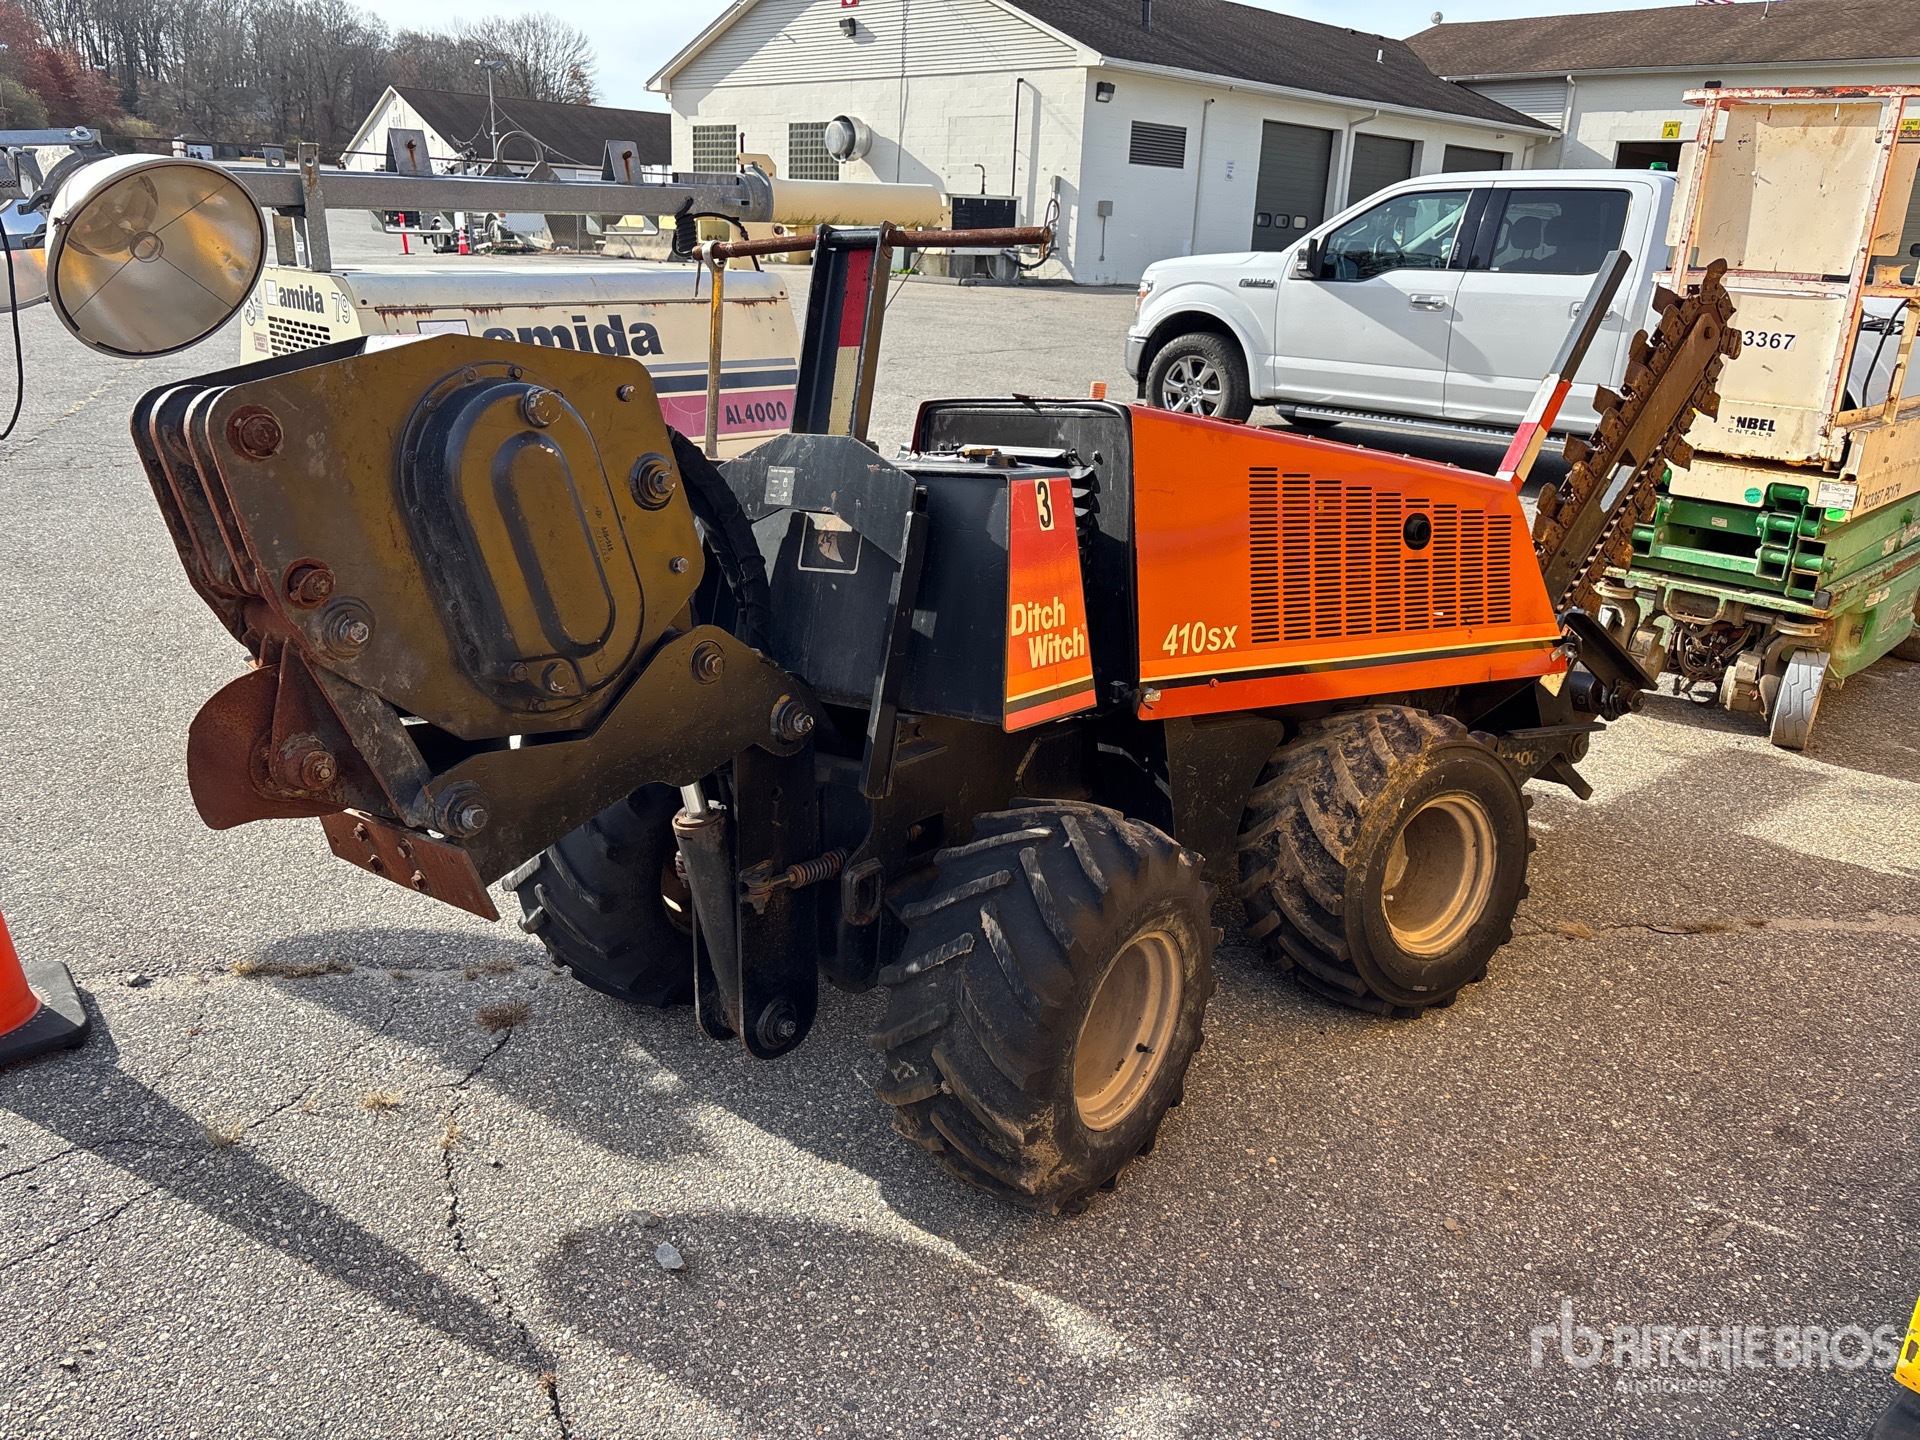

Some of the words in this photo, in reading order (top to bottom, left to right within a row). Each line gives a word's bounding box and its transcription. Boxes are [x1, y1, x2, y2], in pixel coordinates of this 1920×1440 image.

[1666, 128, 1674, 137] A
[278, 284, 325, 314] amida
[331, 291, 351, 324] 79
[725, 400, 788, 426] AL4000
[1037, 480, 1052, 528] 3
[1011, 596, 1066, 637] Ditch
[1028, 627, 1085, 669] Witch
